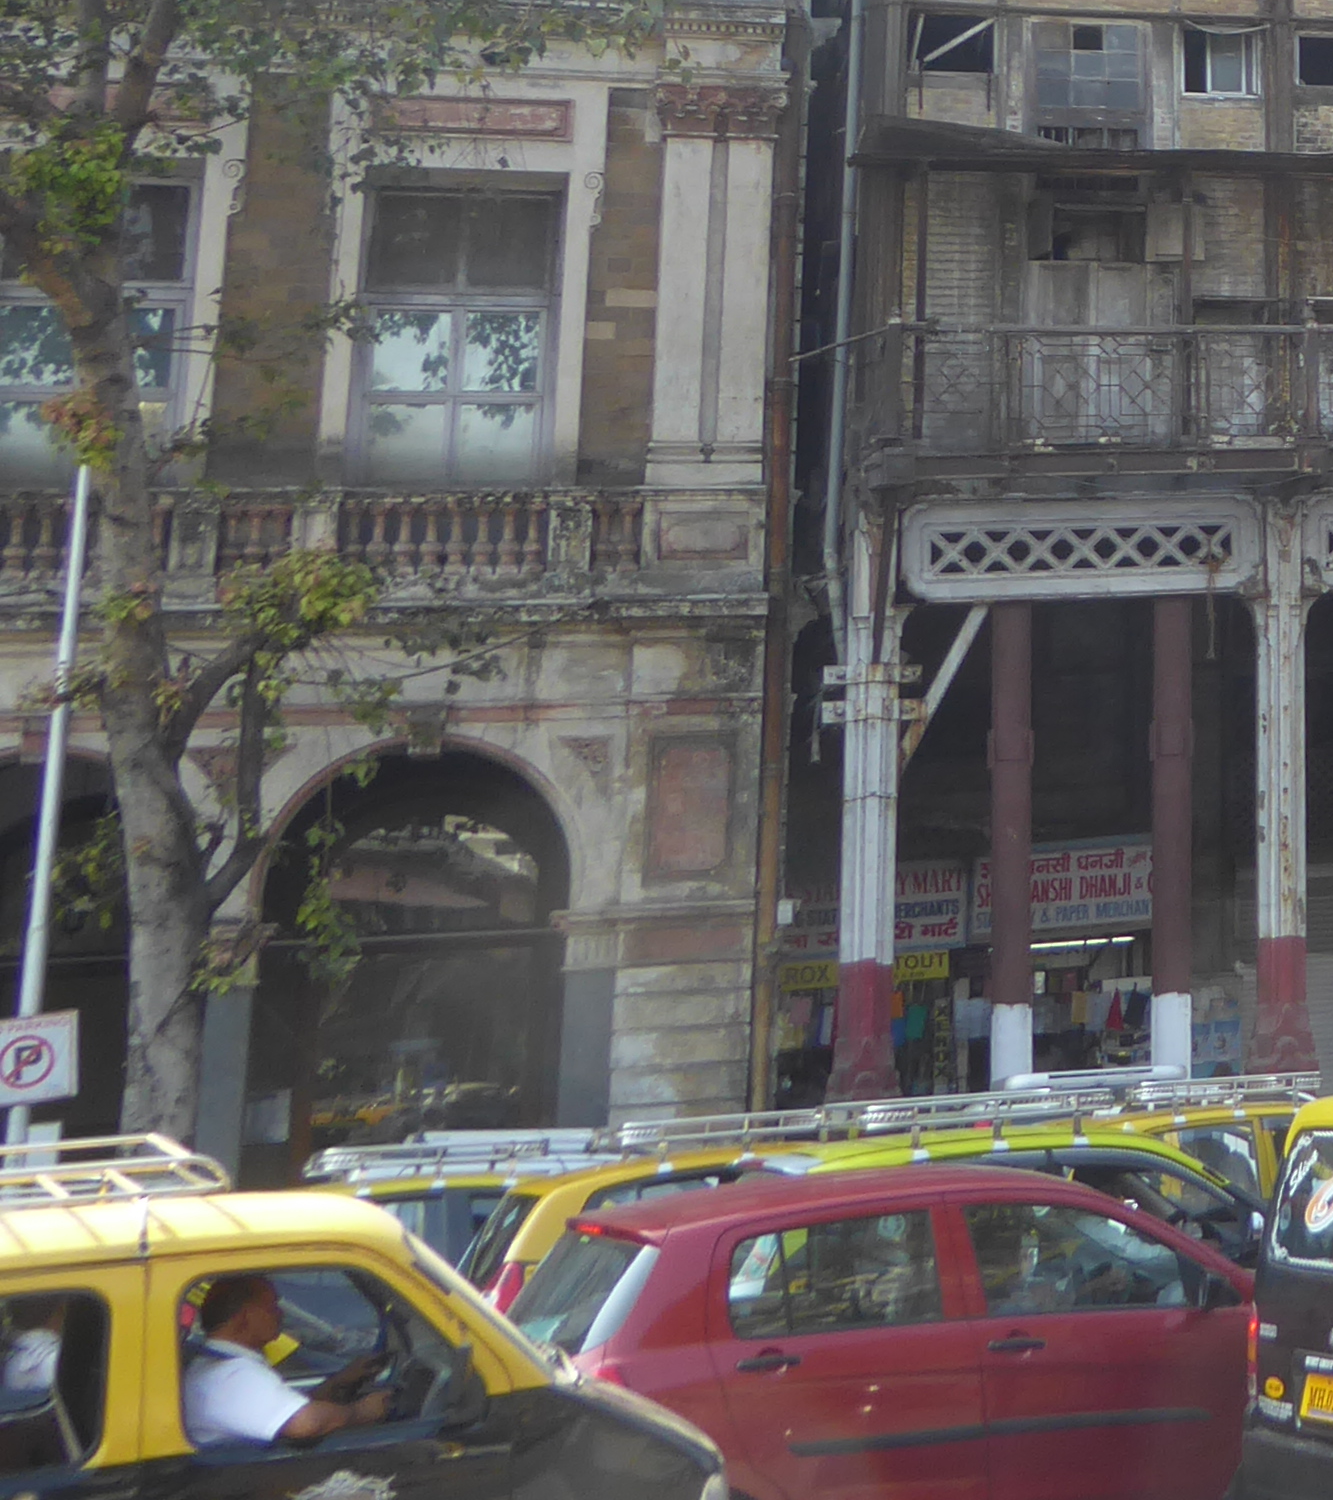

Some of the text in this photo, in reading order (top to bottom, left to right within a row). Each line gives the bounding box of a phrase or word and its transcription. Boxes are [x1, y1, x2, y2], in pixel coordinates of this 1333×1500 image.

[1031, 877, 1072, 904] ANSHI
[1079, 873, 1131, 900] DHANJI
[1096, 900, 1150, 918] MERCHAN
